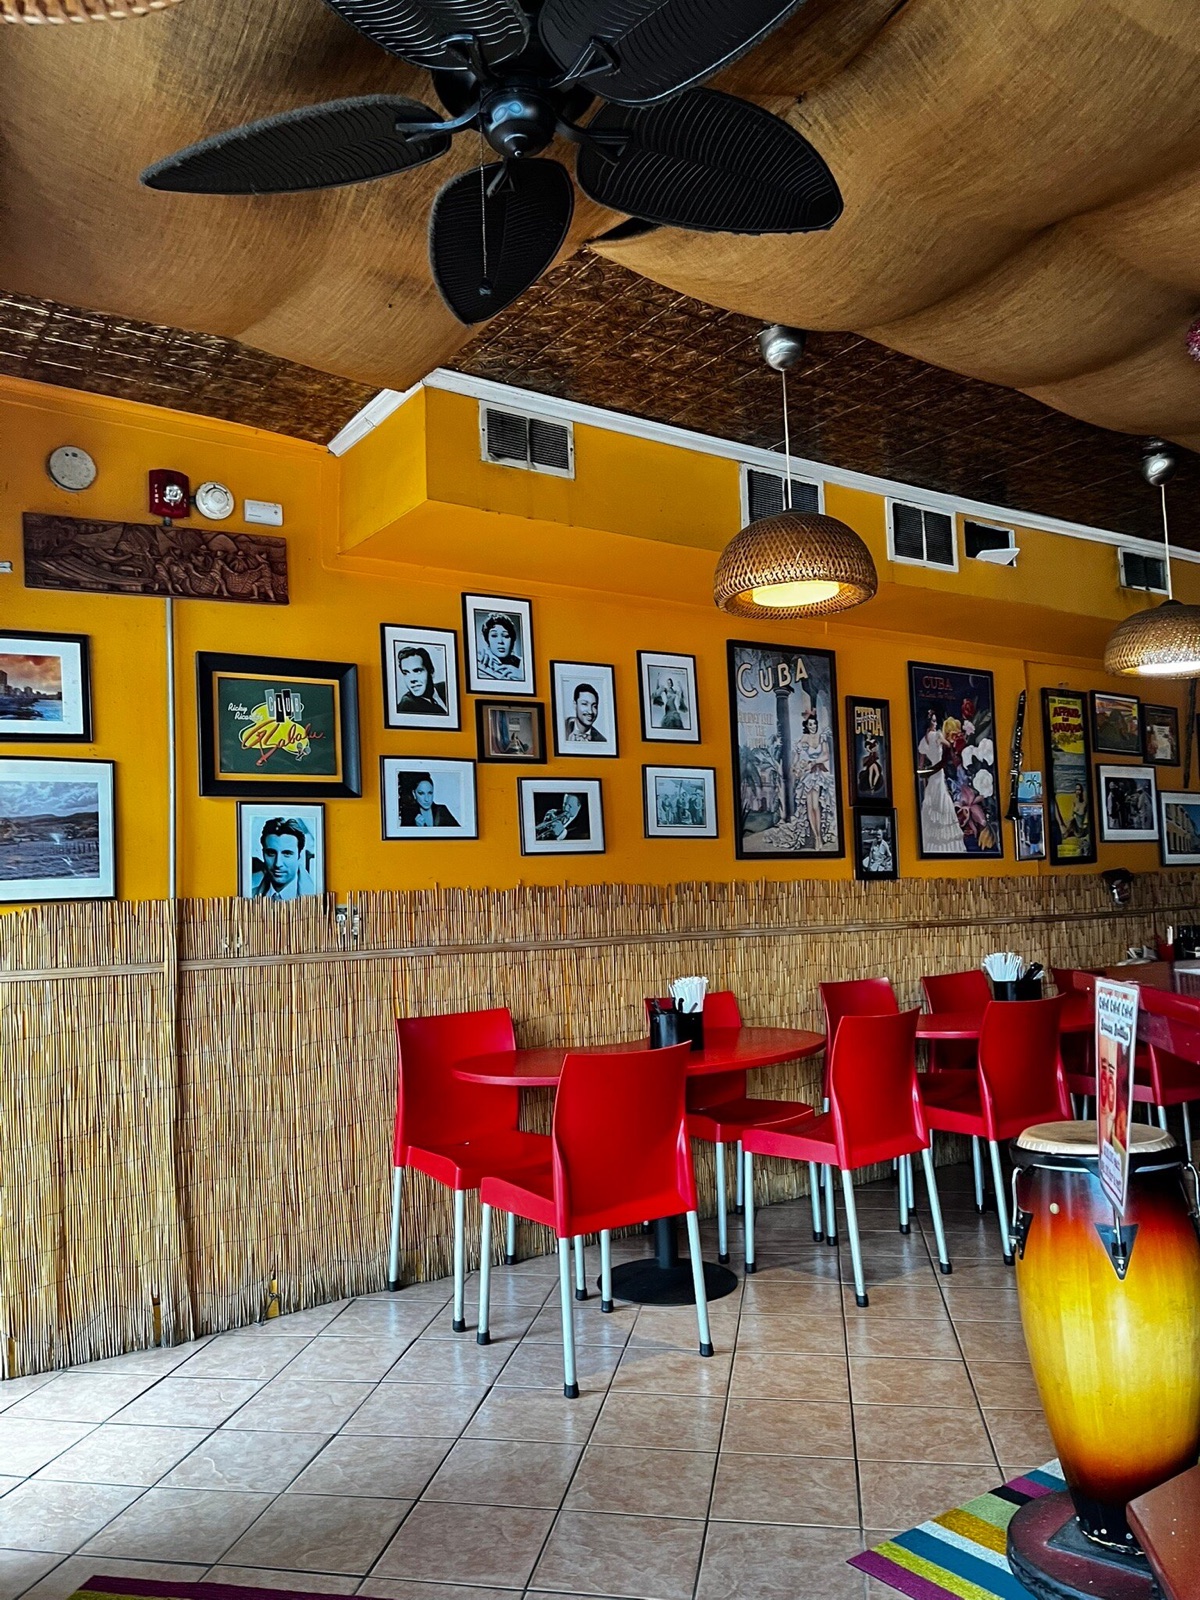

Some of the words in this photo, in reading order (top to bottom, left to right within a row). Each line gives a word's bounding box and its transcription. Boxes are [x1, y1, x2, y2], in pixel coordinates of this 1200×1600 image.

[737, 658, 809, 698] CUBA
[922, 675, 953, 691] CUBA
[228, 702, 248, 715] Ricky
